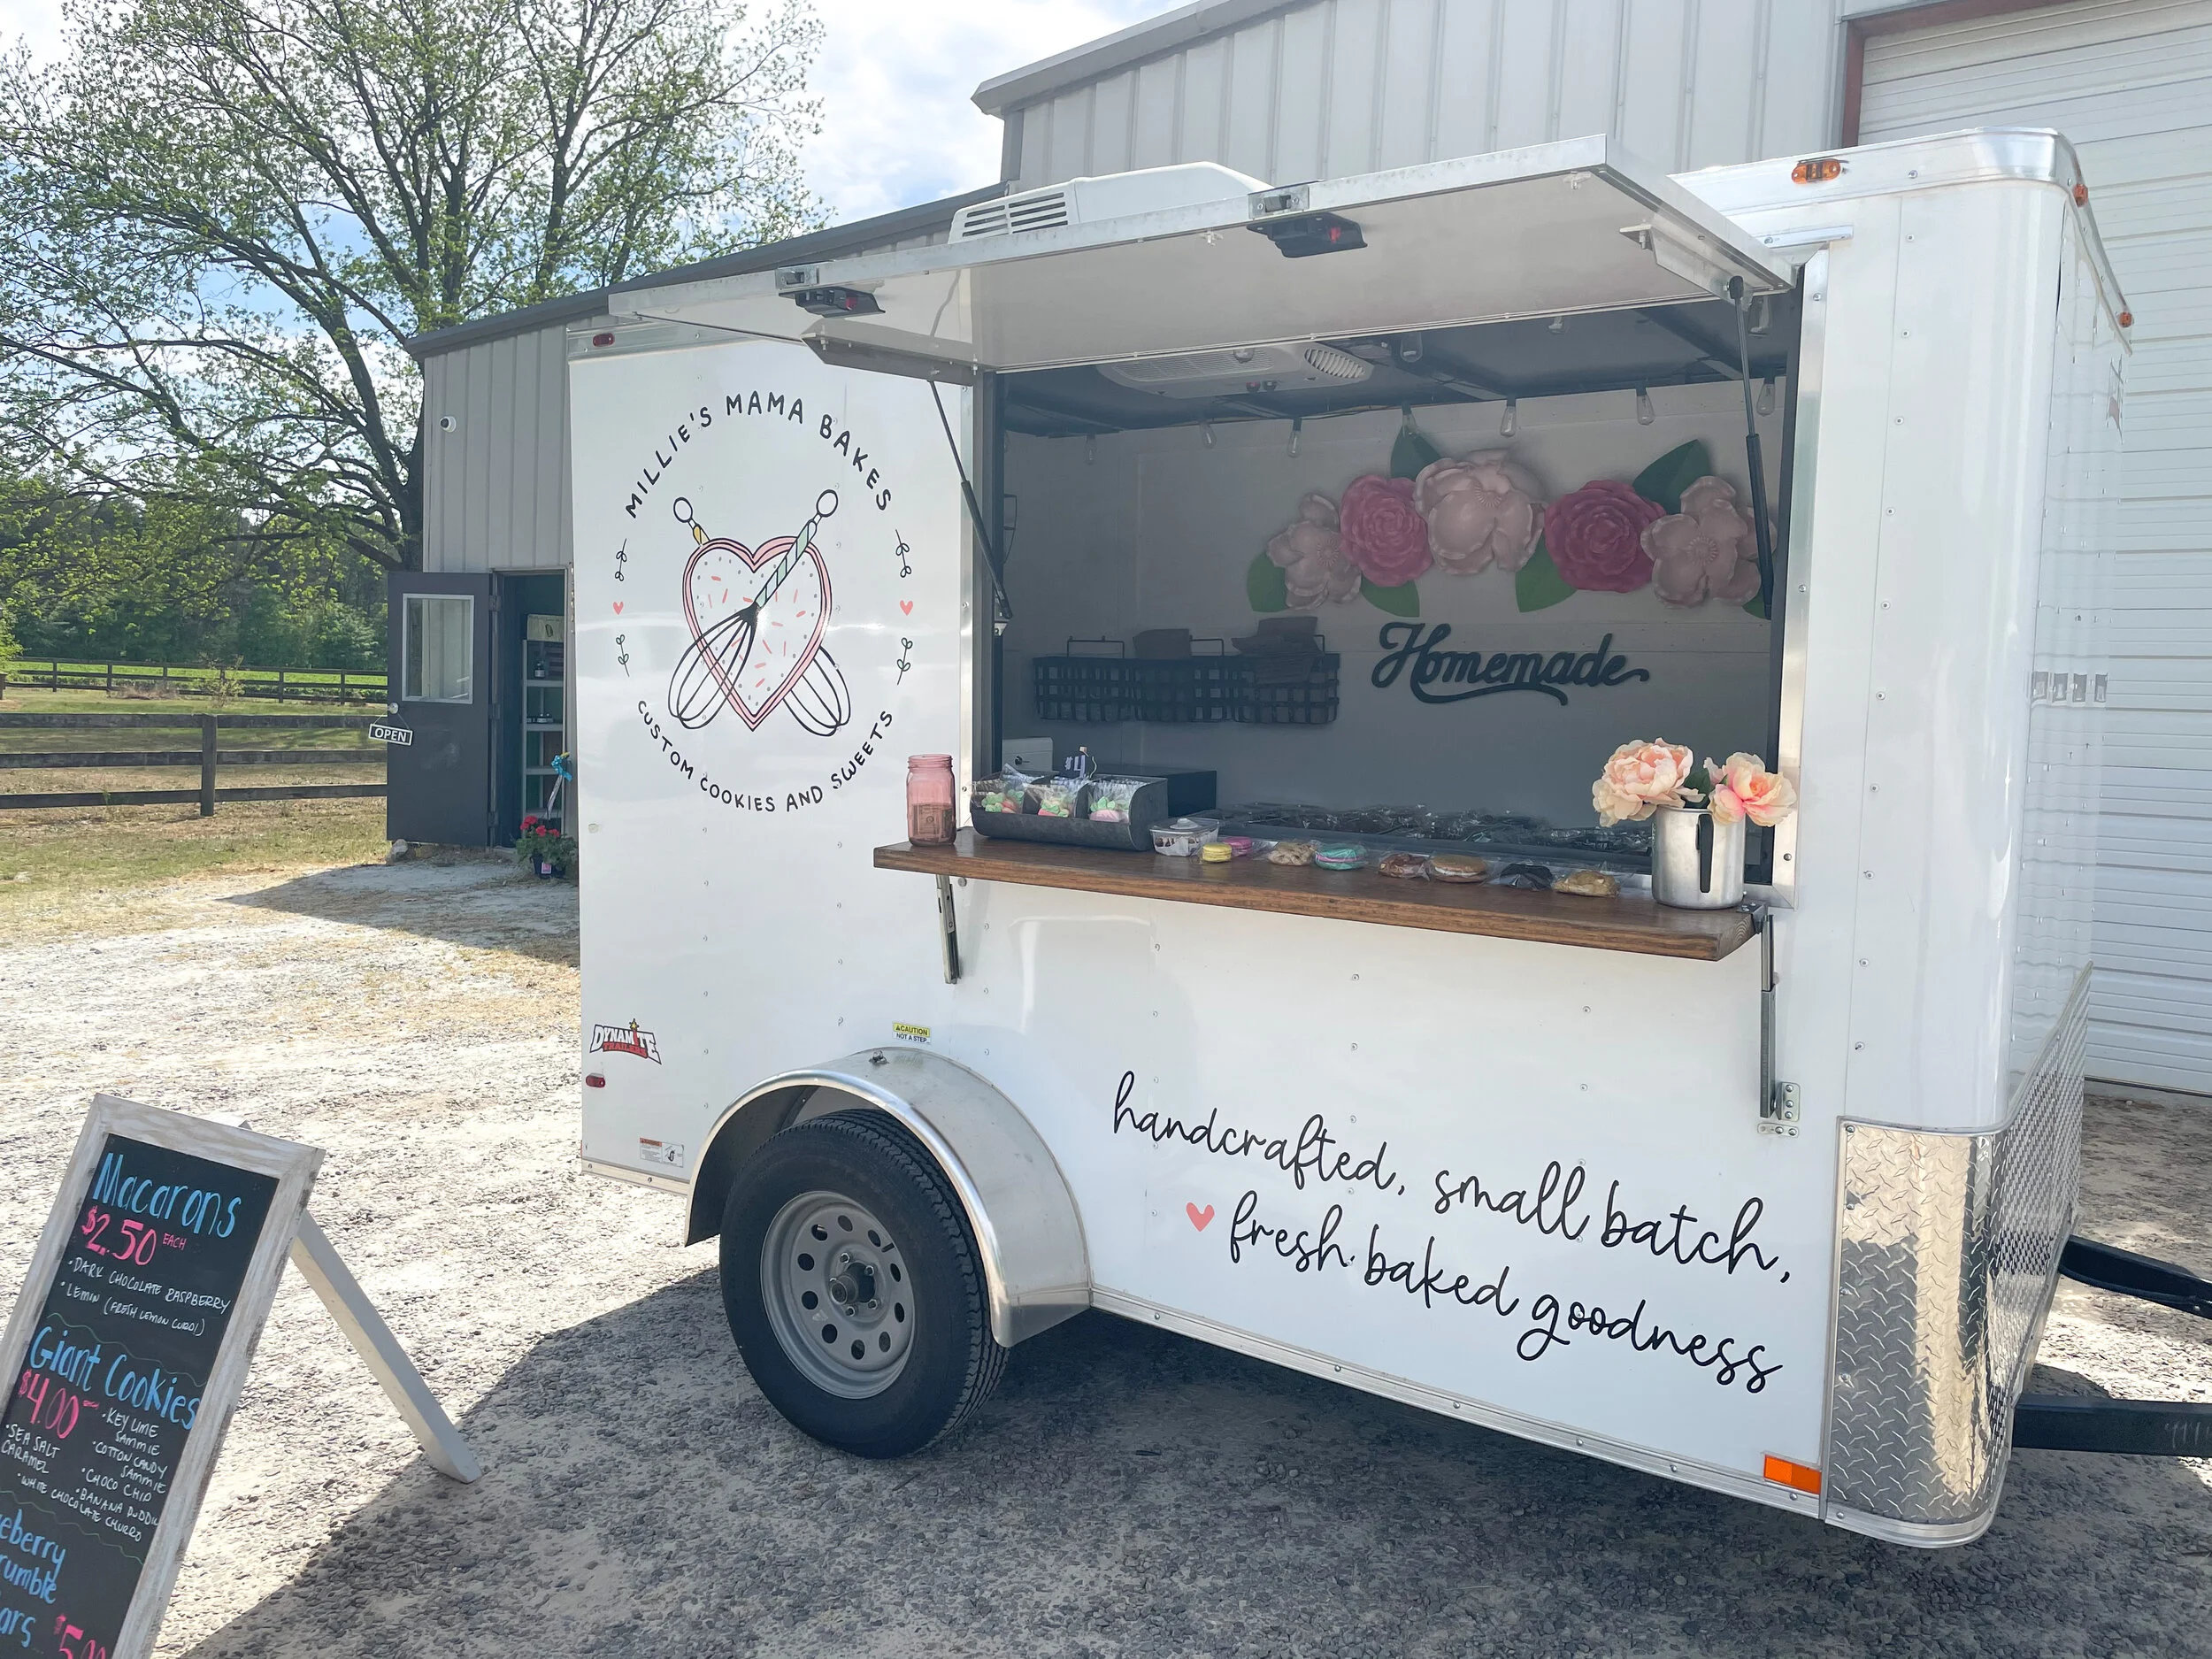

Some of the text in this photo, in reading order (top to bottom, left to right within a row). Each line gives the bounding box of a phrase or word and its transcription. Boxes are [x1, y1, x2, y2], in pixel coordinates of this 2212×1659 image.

[625, 390, 892, 518] MILLIE'S MAMA BAKES
[1371, 621, 1650, 706] Homemade
[374, 727, 407, 742] OPEN
[638, 699, 894, 813] CUSTOM COOKIES AND SWEETS
[589, 1023, 662, 1065] DYNAMITE
[900, 1025, 928, 1036] CAUTION
[92, 1152, 242, 1239] Macarons
[1113, 1070, 1792, 1284] handcrafted, small batch,
[81, 1205, 187, 1266] $2.50 EACH
[73, 1256, 232, 1315] DARK CHOCOLATE RASPBERRY
[104, 1296, 138, 1318] (FRESH
[140, 1310, 170, 1325] LEMON
[1365, 1223, 1518, 1317] baked
[1516, 1294, 1784, 1394] goodness
[30, 1325, 201, 1430] Giant Cookies
[18, 1369, 80, 1440] $4.00
[106, 1407, 130, 1431] KEY
[1, 1439, 50, 1474] CARAMEL
[8, 1424, 61, 1459] SEA SALT
[95, 1441, 168, 1480] COTTON CANDY
[115, 1430, 161, 1455] SAMMIE
[80, 1487, 123, 1513] BANANA
[86, 1468, 153, 1502] CHOCO CHIP
[120, 1465, 166, 1494] SAMMIE
[21, 1475, 142, 1542] WHITE CHOCOLATE CHURRO
[0, 1509, 66, 1583] eberry
